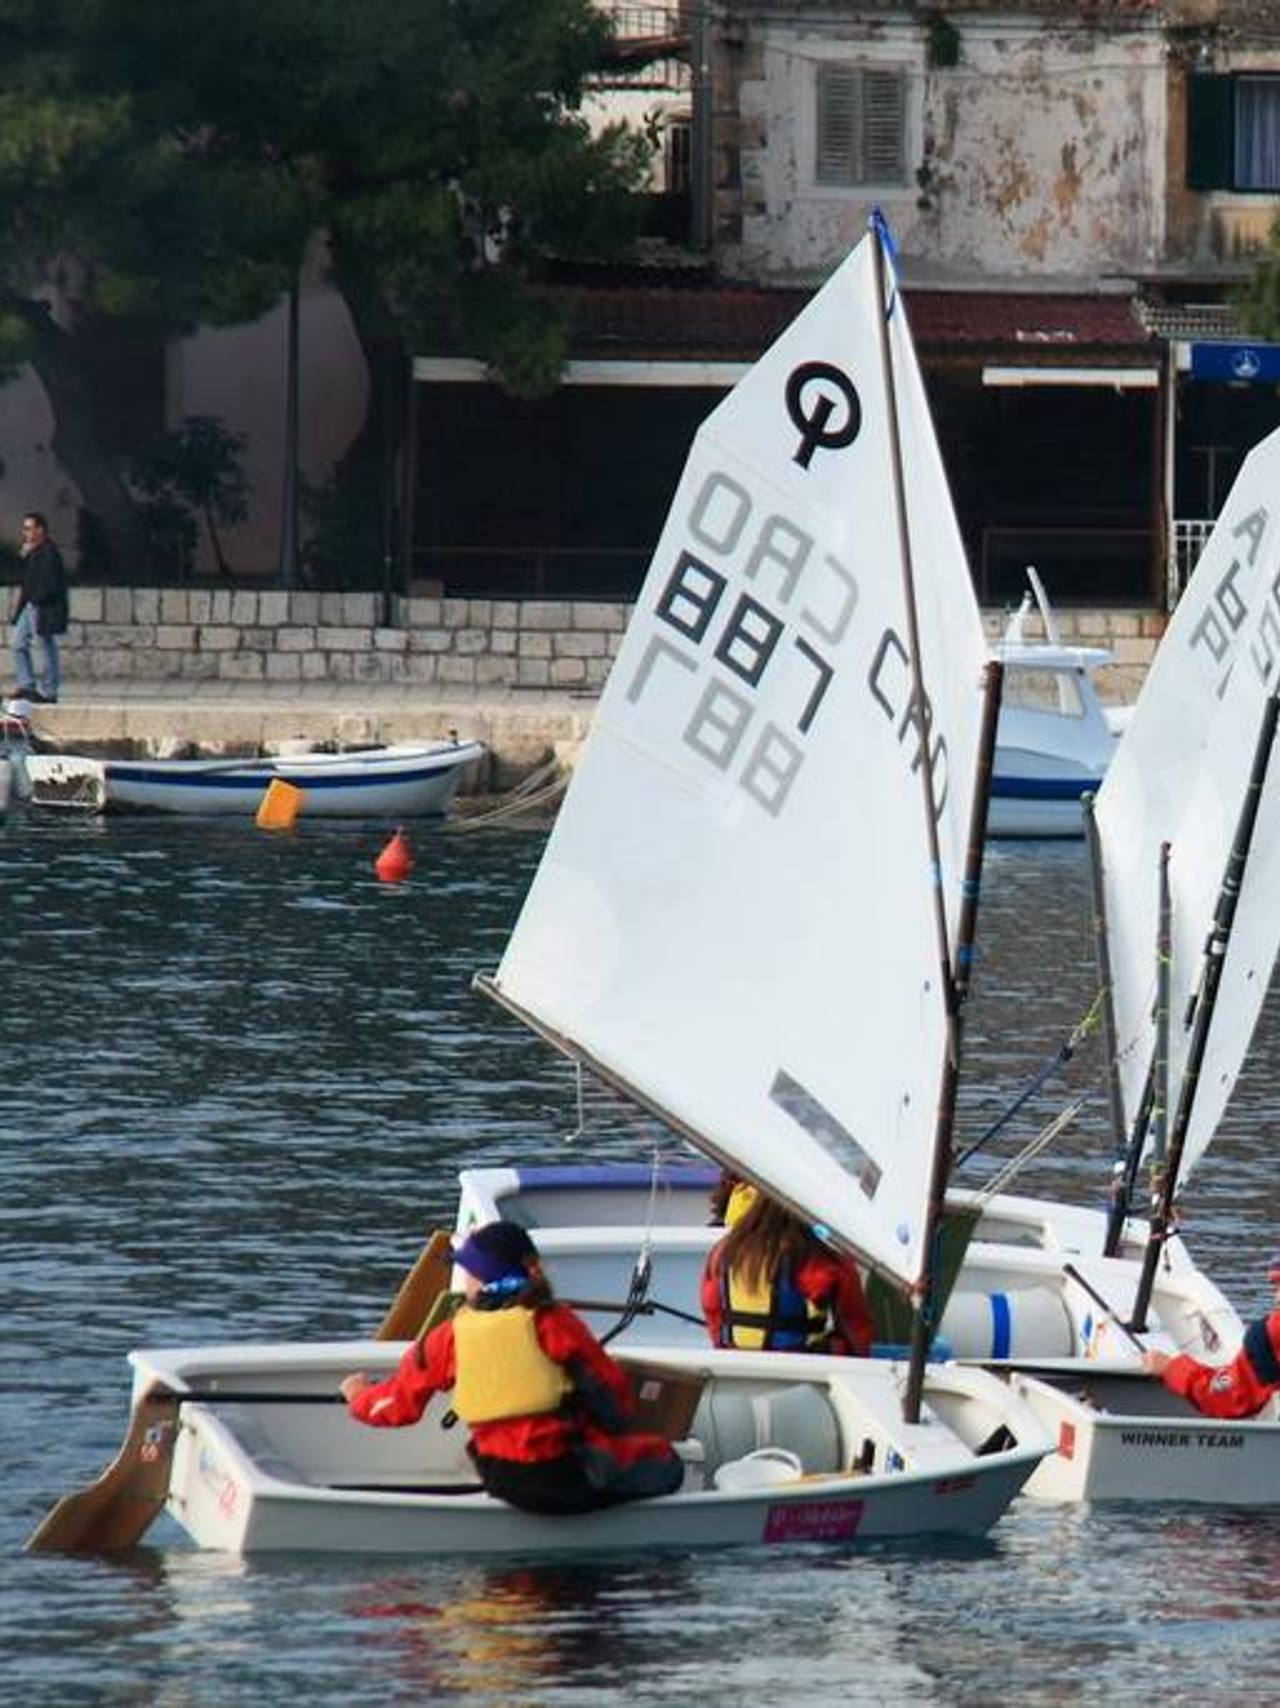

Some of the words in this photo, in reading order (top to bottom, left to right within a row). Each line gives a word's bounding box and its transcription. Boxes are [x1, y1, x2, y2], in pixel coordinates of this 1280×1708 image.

[654, 549, 835, 736] 887
[1121, 1432, 1190, 1447] WINNER
[1197, 1433, 1246, 1448] TEAM
